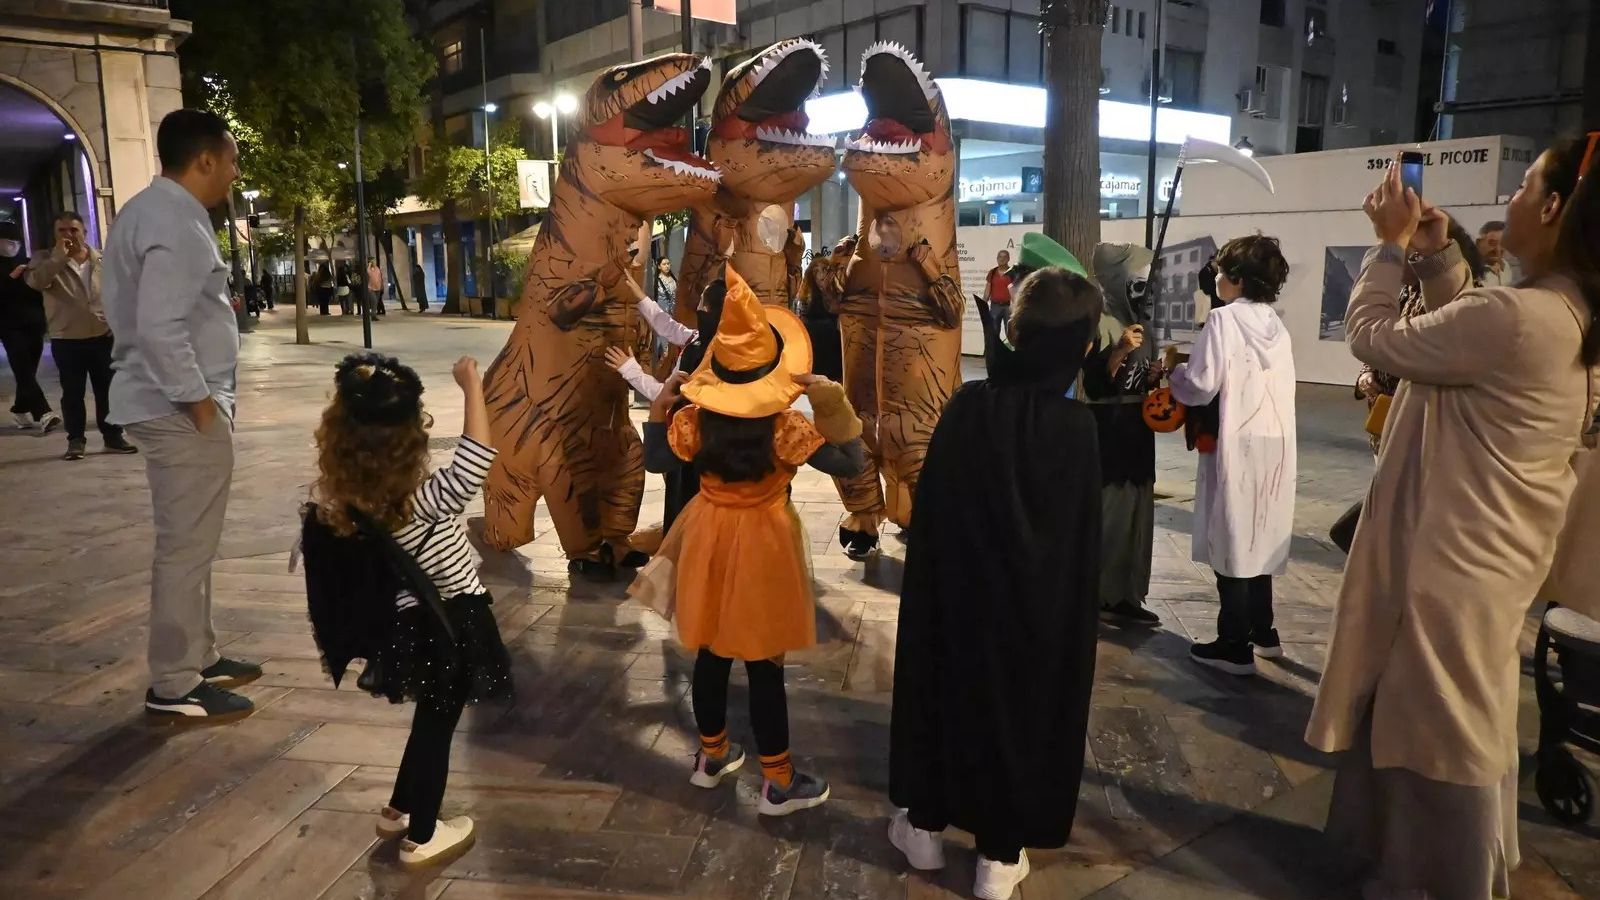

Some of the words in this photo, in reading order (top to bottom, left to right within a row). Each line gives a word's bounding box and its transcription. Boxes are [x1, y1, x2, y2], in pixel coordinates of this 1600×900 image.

[1440, 148, 1489, 165] PICOTE
[969, 179, 1018, 196] cajamar
[1100, 176, 1141, 193] cajamar
